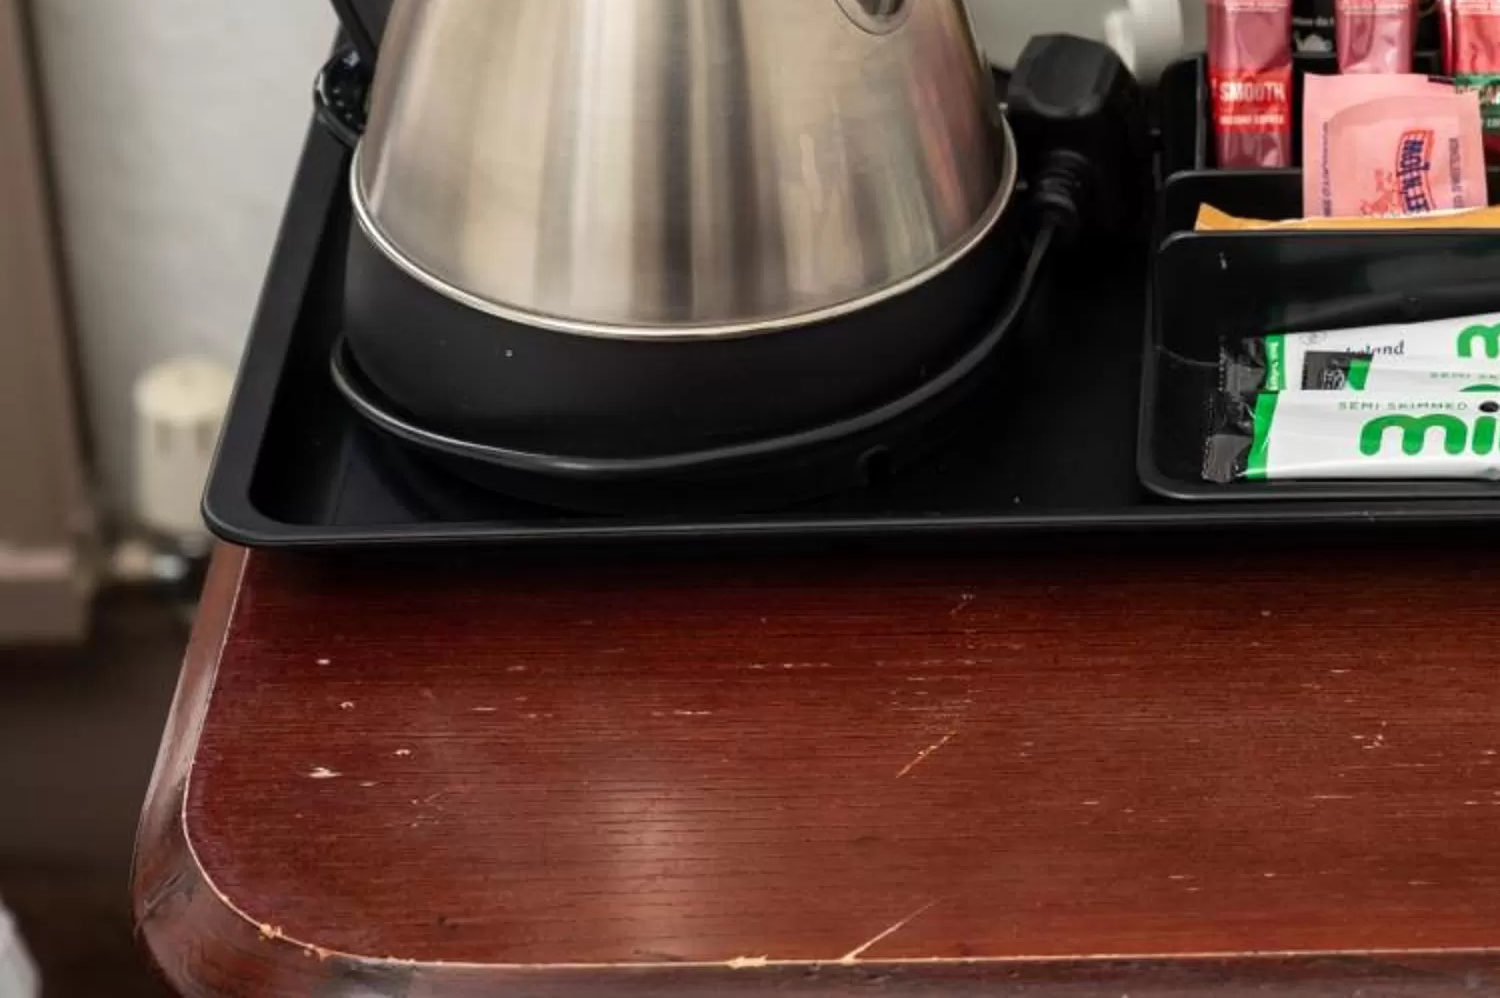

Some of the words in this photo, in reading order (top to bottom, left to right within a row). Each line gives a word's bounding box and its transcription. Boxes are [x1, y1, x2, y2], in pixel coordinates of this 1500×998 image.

[1220, 81, 1285, 101] SMOOTH
[1338, 401, 1380, 412] SEMI
[1386, 401, 1469, 412] SKIMMED
